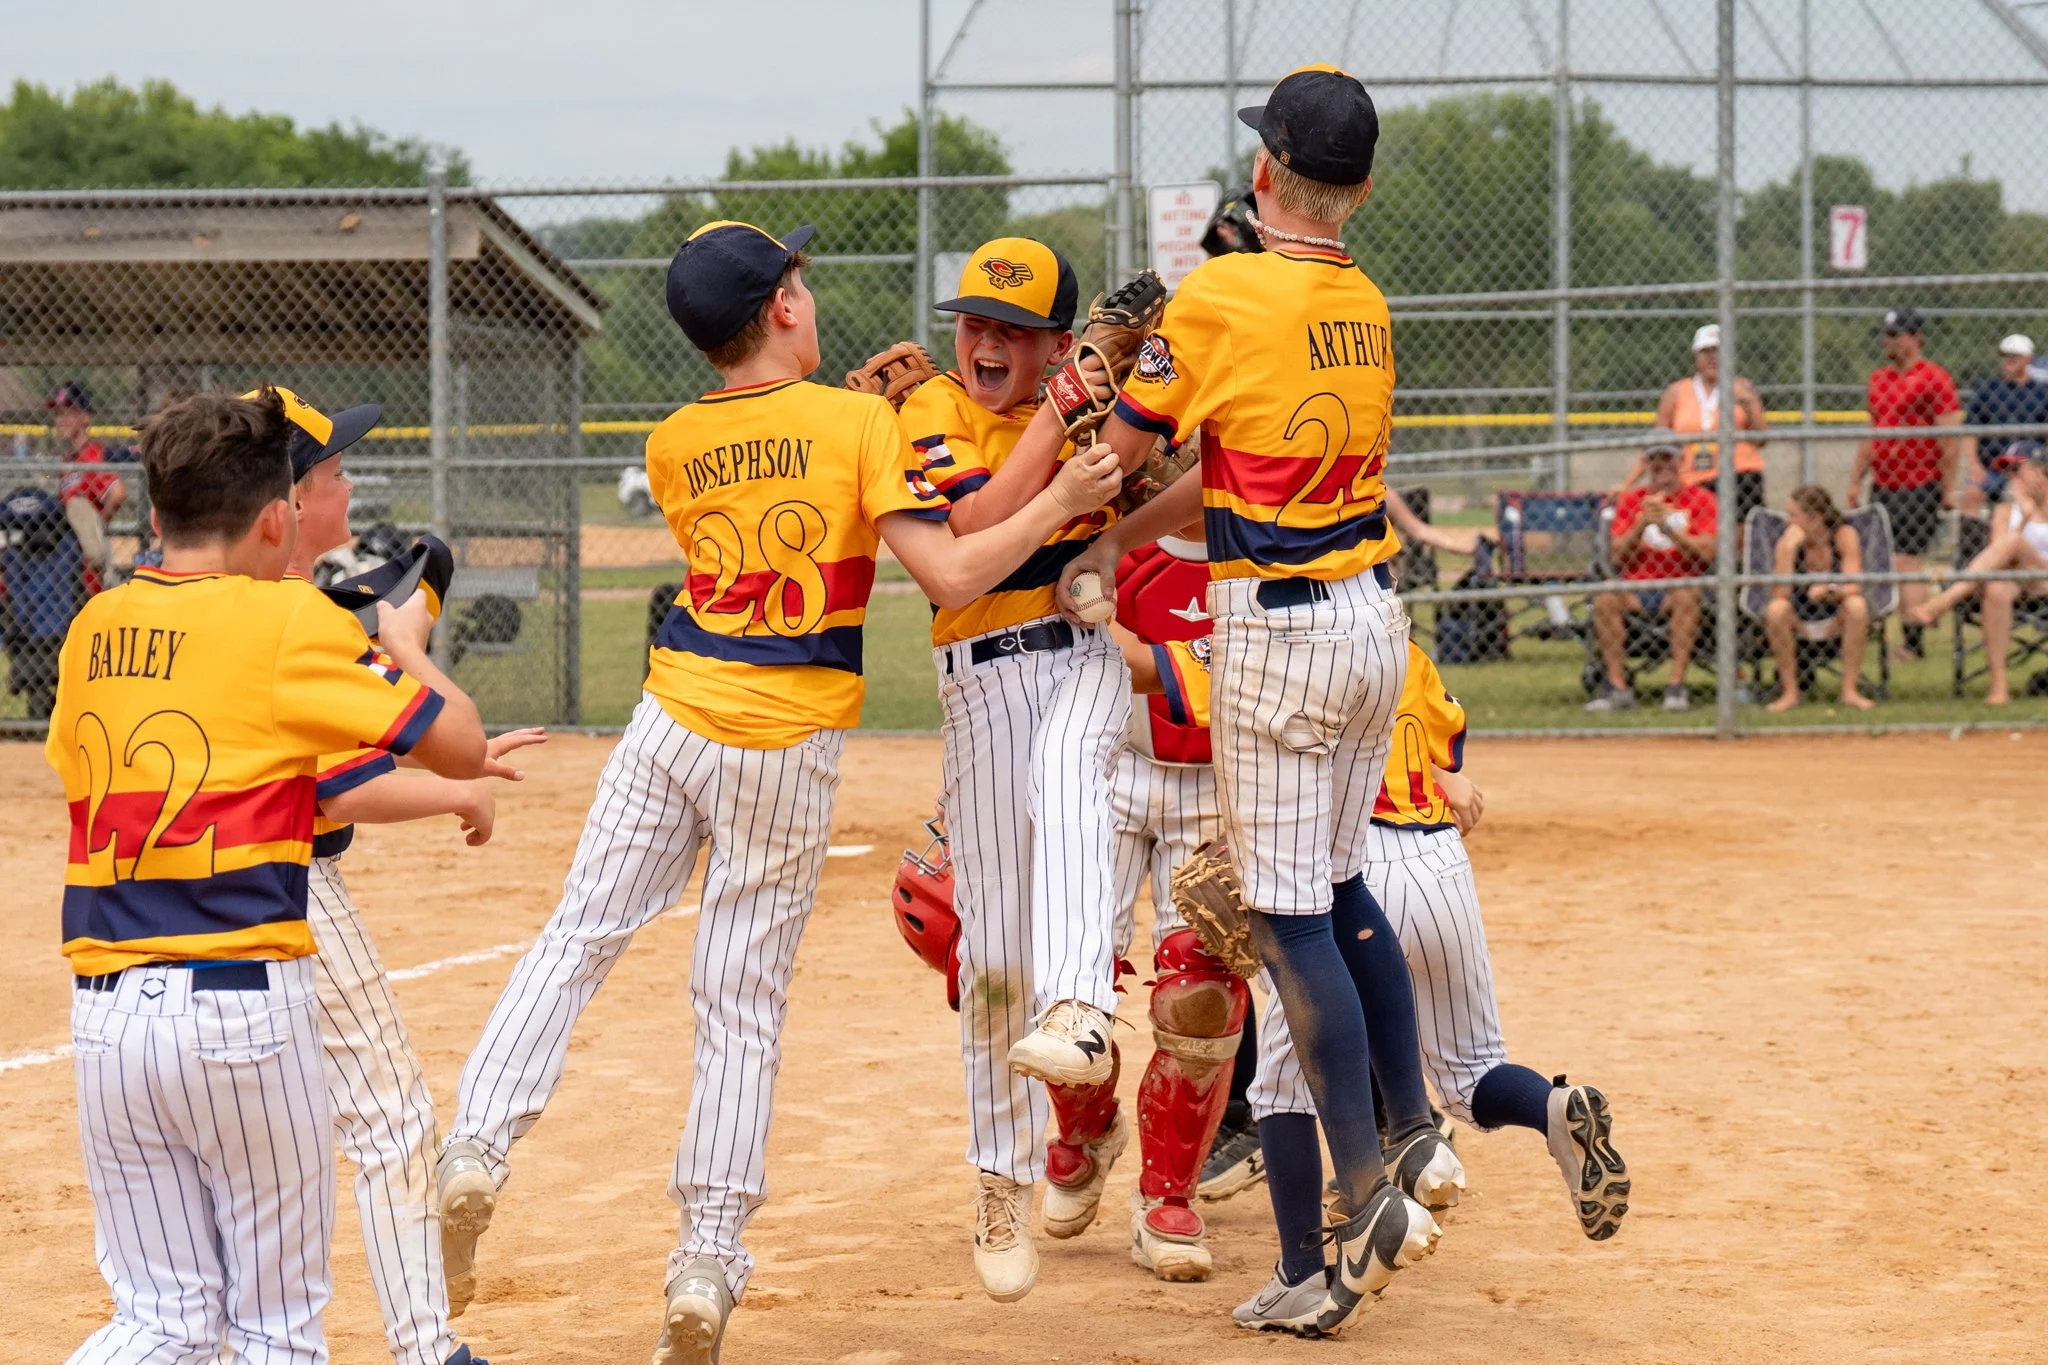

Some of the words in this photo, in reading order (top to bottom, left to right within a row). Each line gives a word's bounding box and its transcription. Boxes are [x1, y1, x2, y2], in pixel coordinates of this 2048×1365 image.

[1834, 211, 1864, 260] 7
[1055, 373, 1080, 403] Rawlings
[683, 438, 813, 499] JOSEPHSON
[687, 500, 828, 638] 28
[87, 627, 187, 682] BAILEY
[74, 709, 217, 885] 22
